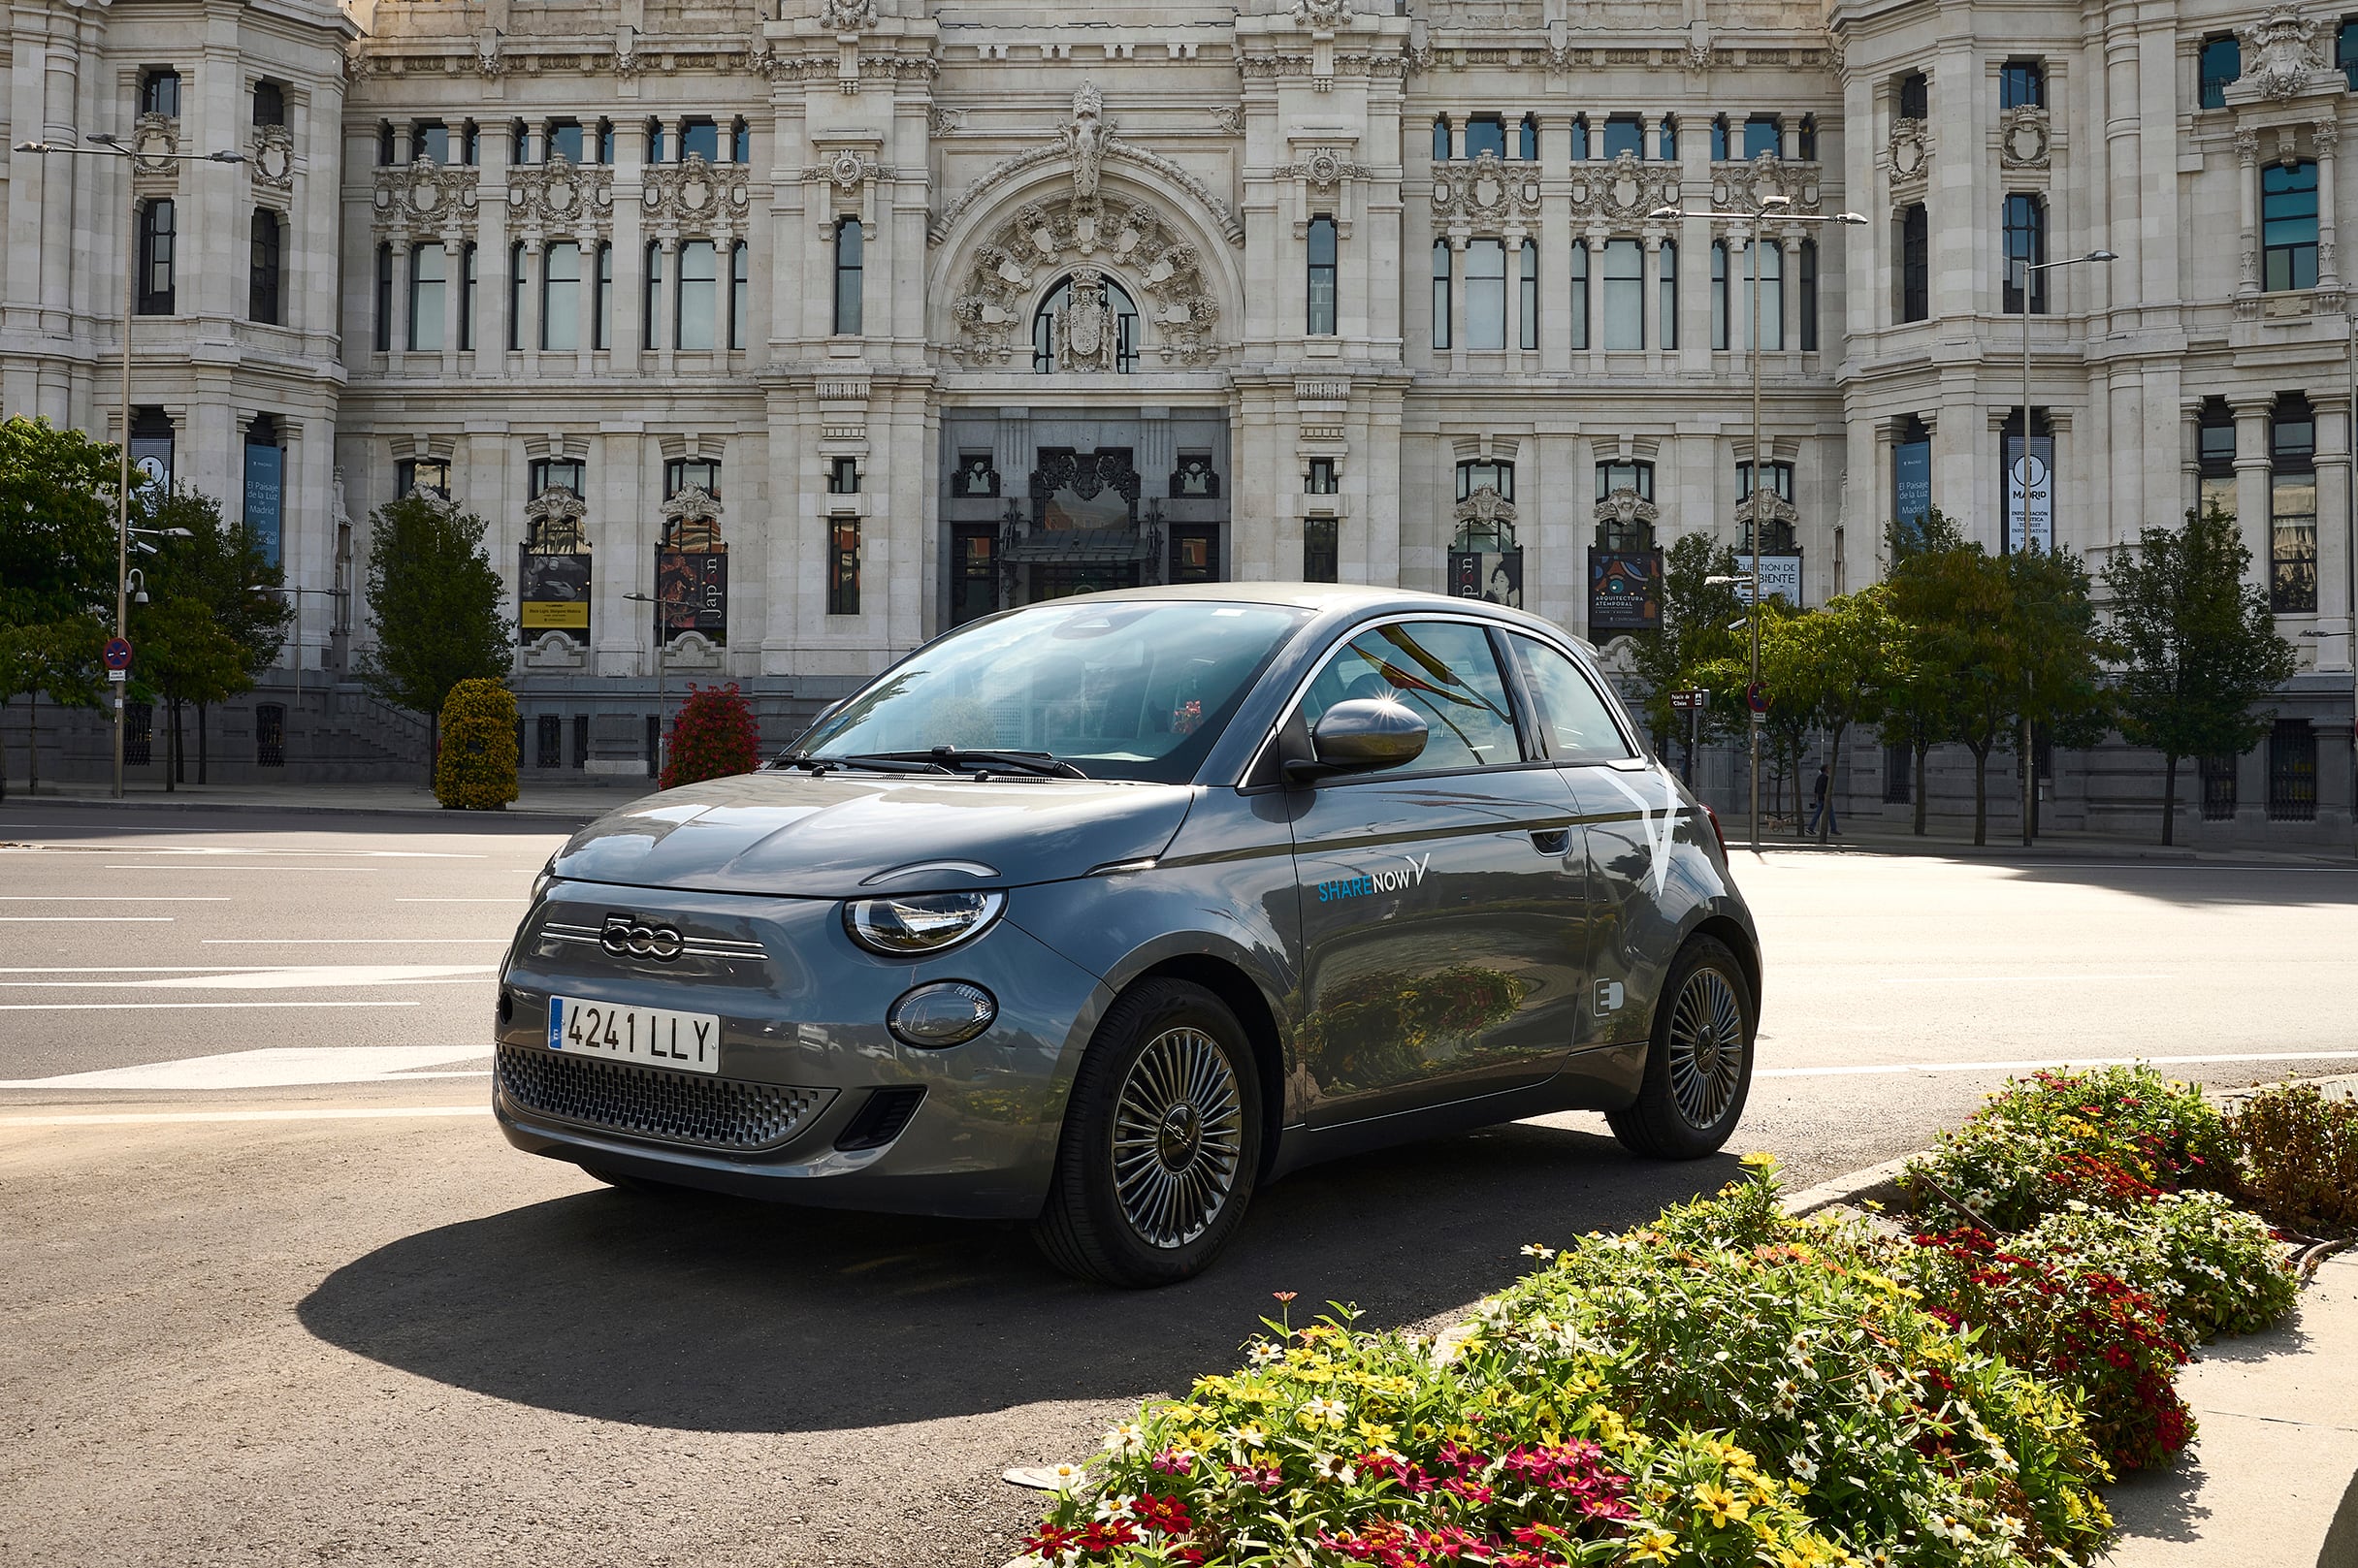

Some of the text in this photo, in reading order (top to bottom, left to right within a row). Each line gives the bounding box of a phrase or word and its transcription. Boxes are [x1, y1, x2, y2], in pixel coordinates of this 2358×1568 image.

[255, 482, 278, 493] Paisaje
[1906, 480, 1928, 491] Paisaje
[266, 492, 278, 500] Luz
[1909, 490, 1915, 498] la
[249, 505, 275, 515] Madrid
[1902, 505, 1925, 515] Madrid
[1783, 563, 1795, 572] DE
[601, 915, 683, 958] 500
[553, 1029, 559, 1040] E
[568, 1006, 710, 1063] 4241 LLY
